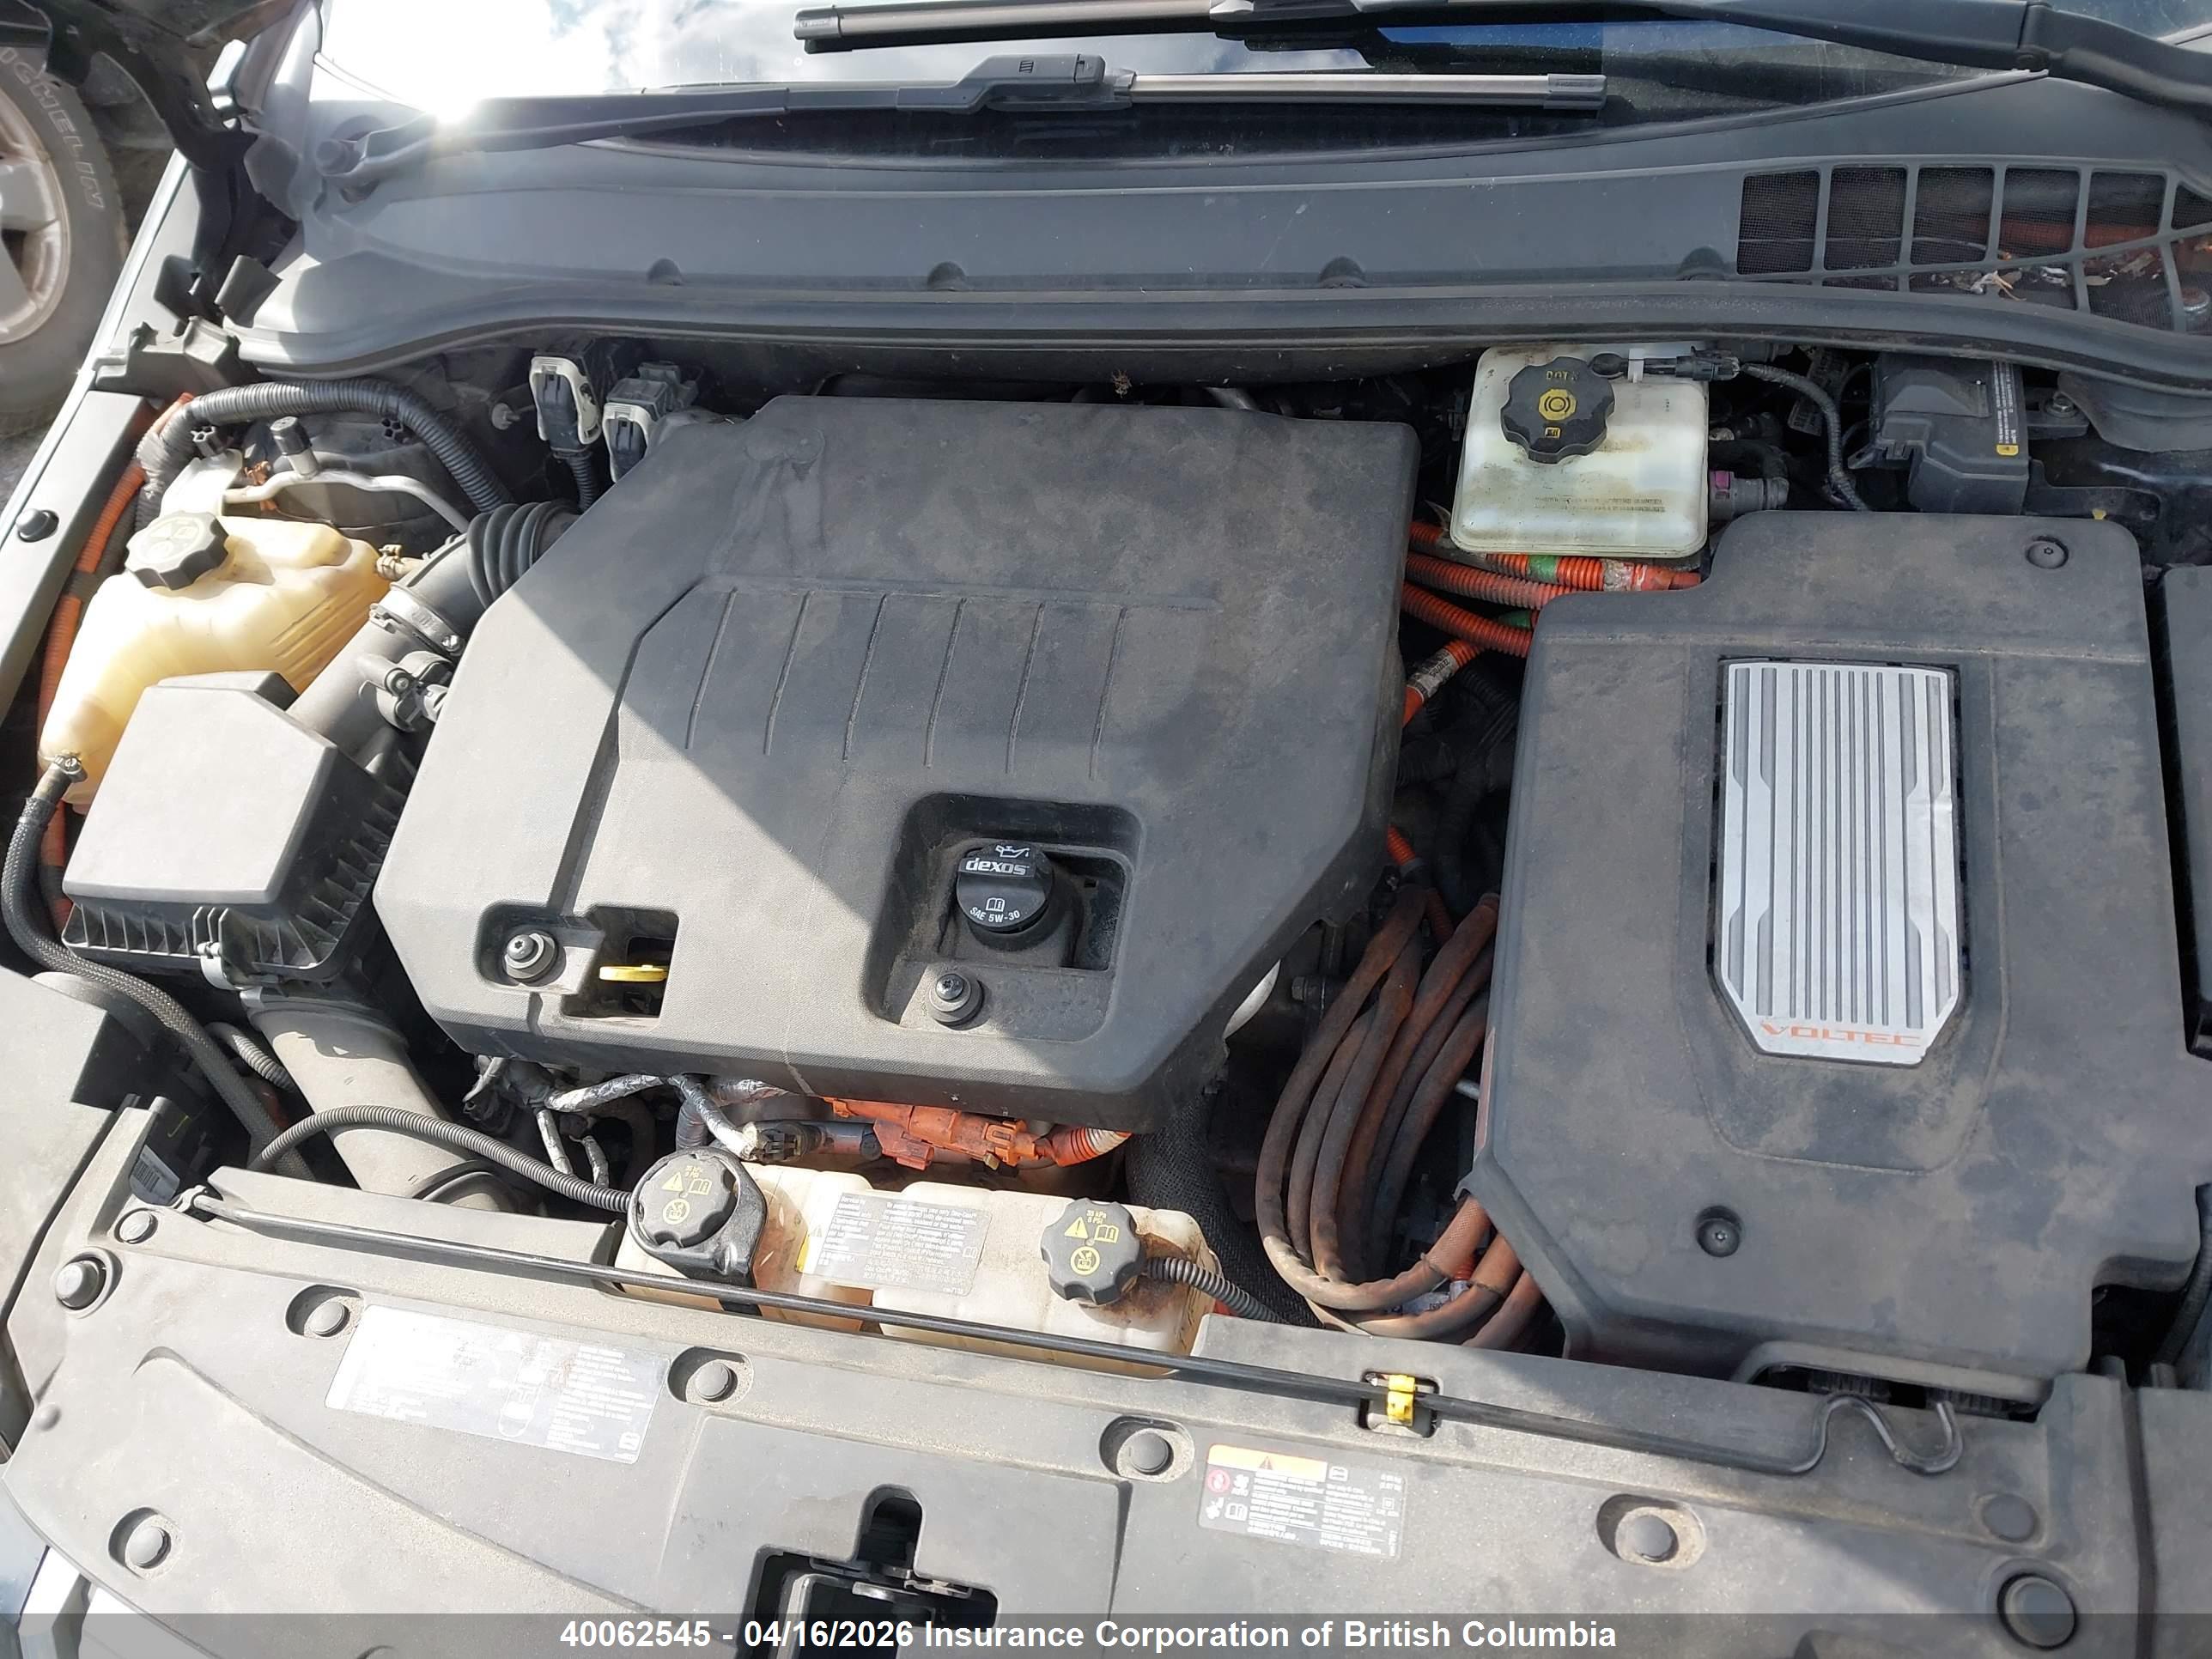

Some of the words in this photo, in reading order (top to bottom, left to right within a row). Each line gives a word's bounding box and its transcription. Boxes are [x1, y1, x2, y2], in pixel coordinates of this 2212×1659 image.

[965, 857, 1027, 876] dexos
[969, 907, 987, 921] SAE
[988, 909, 1021, 923] 5W-30
[1760, 1022, 1921, 1048] VOLTEC
